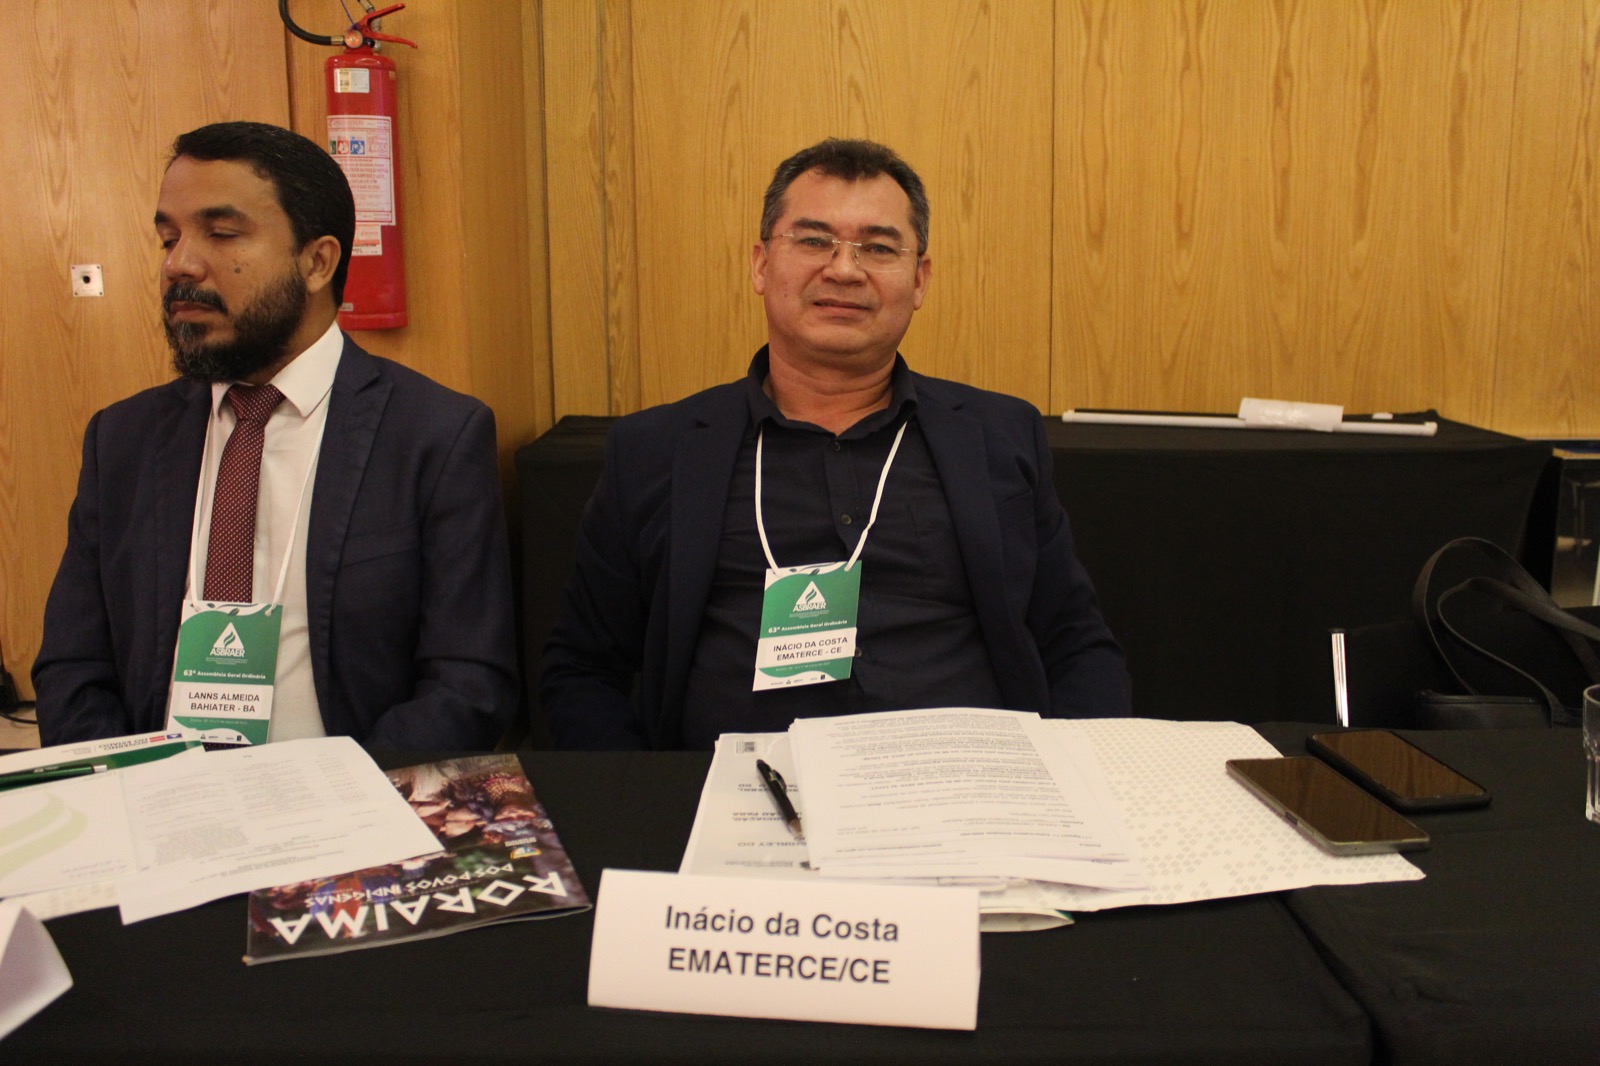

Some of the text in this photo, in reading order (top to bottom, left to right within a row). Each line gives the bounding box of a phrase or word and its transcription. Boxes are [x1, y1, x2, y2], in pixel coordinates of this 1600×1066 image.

[792, 602, 827, 612] ASBRAER
[773, 636, 848, 652] INÁCIO DA COSTA
[209, 647, 245, 658] ASBRAER
[777, 649, 823, 661] EMATERCE
[830, 646, 842, 654] CE
[188, 691, 260, 702] LANNS ALMEIDA
[190, 704, 236, 713] BAHIATER
[242, 705, 256, 713] BA
[304, 862, 515, 909] DOS POVOS INDÍGENAS
[268, 871, 568, 945] RORAIMA
[665, 905, 900, 943] Inácio da Costa
[668, 947, 891, 984] EMATERCE/CE
